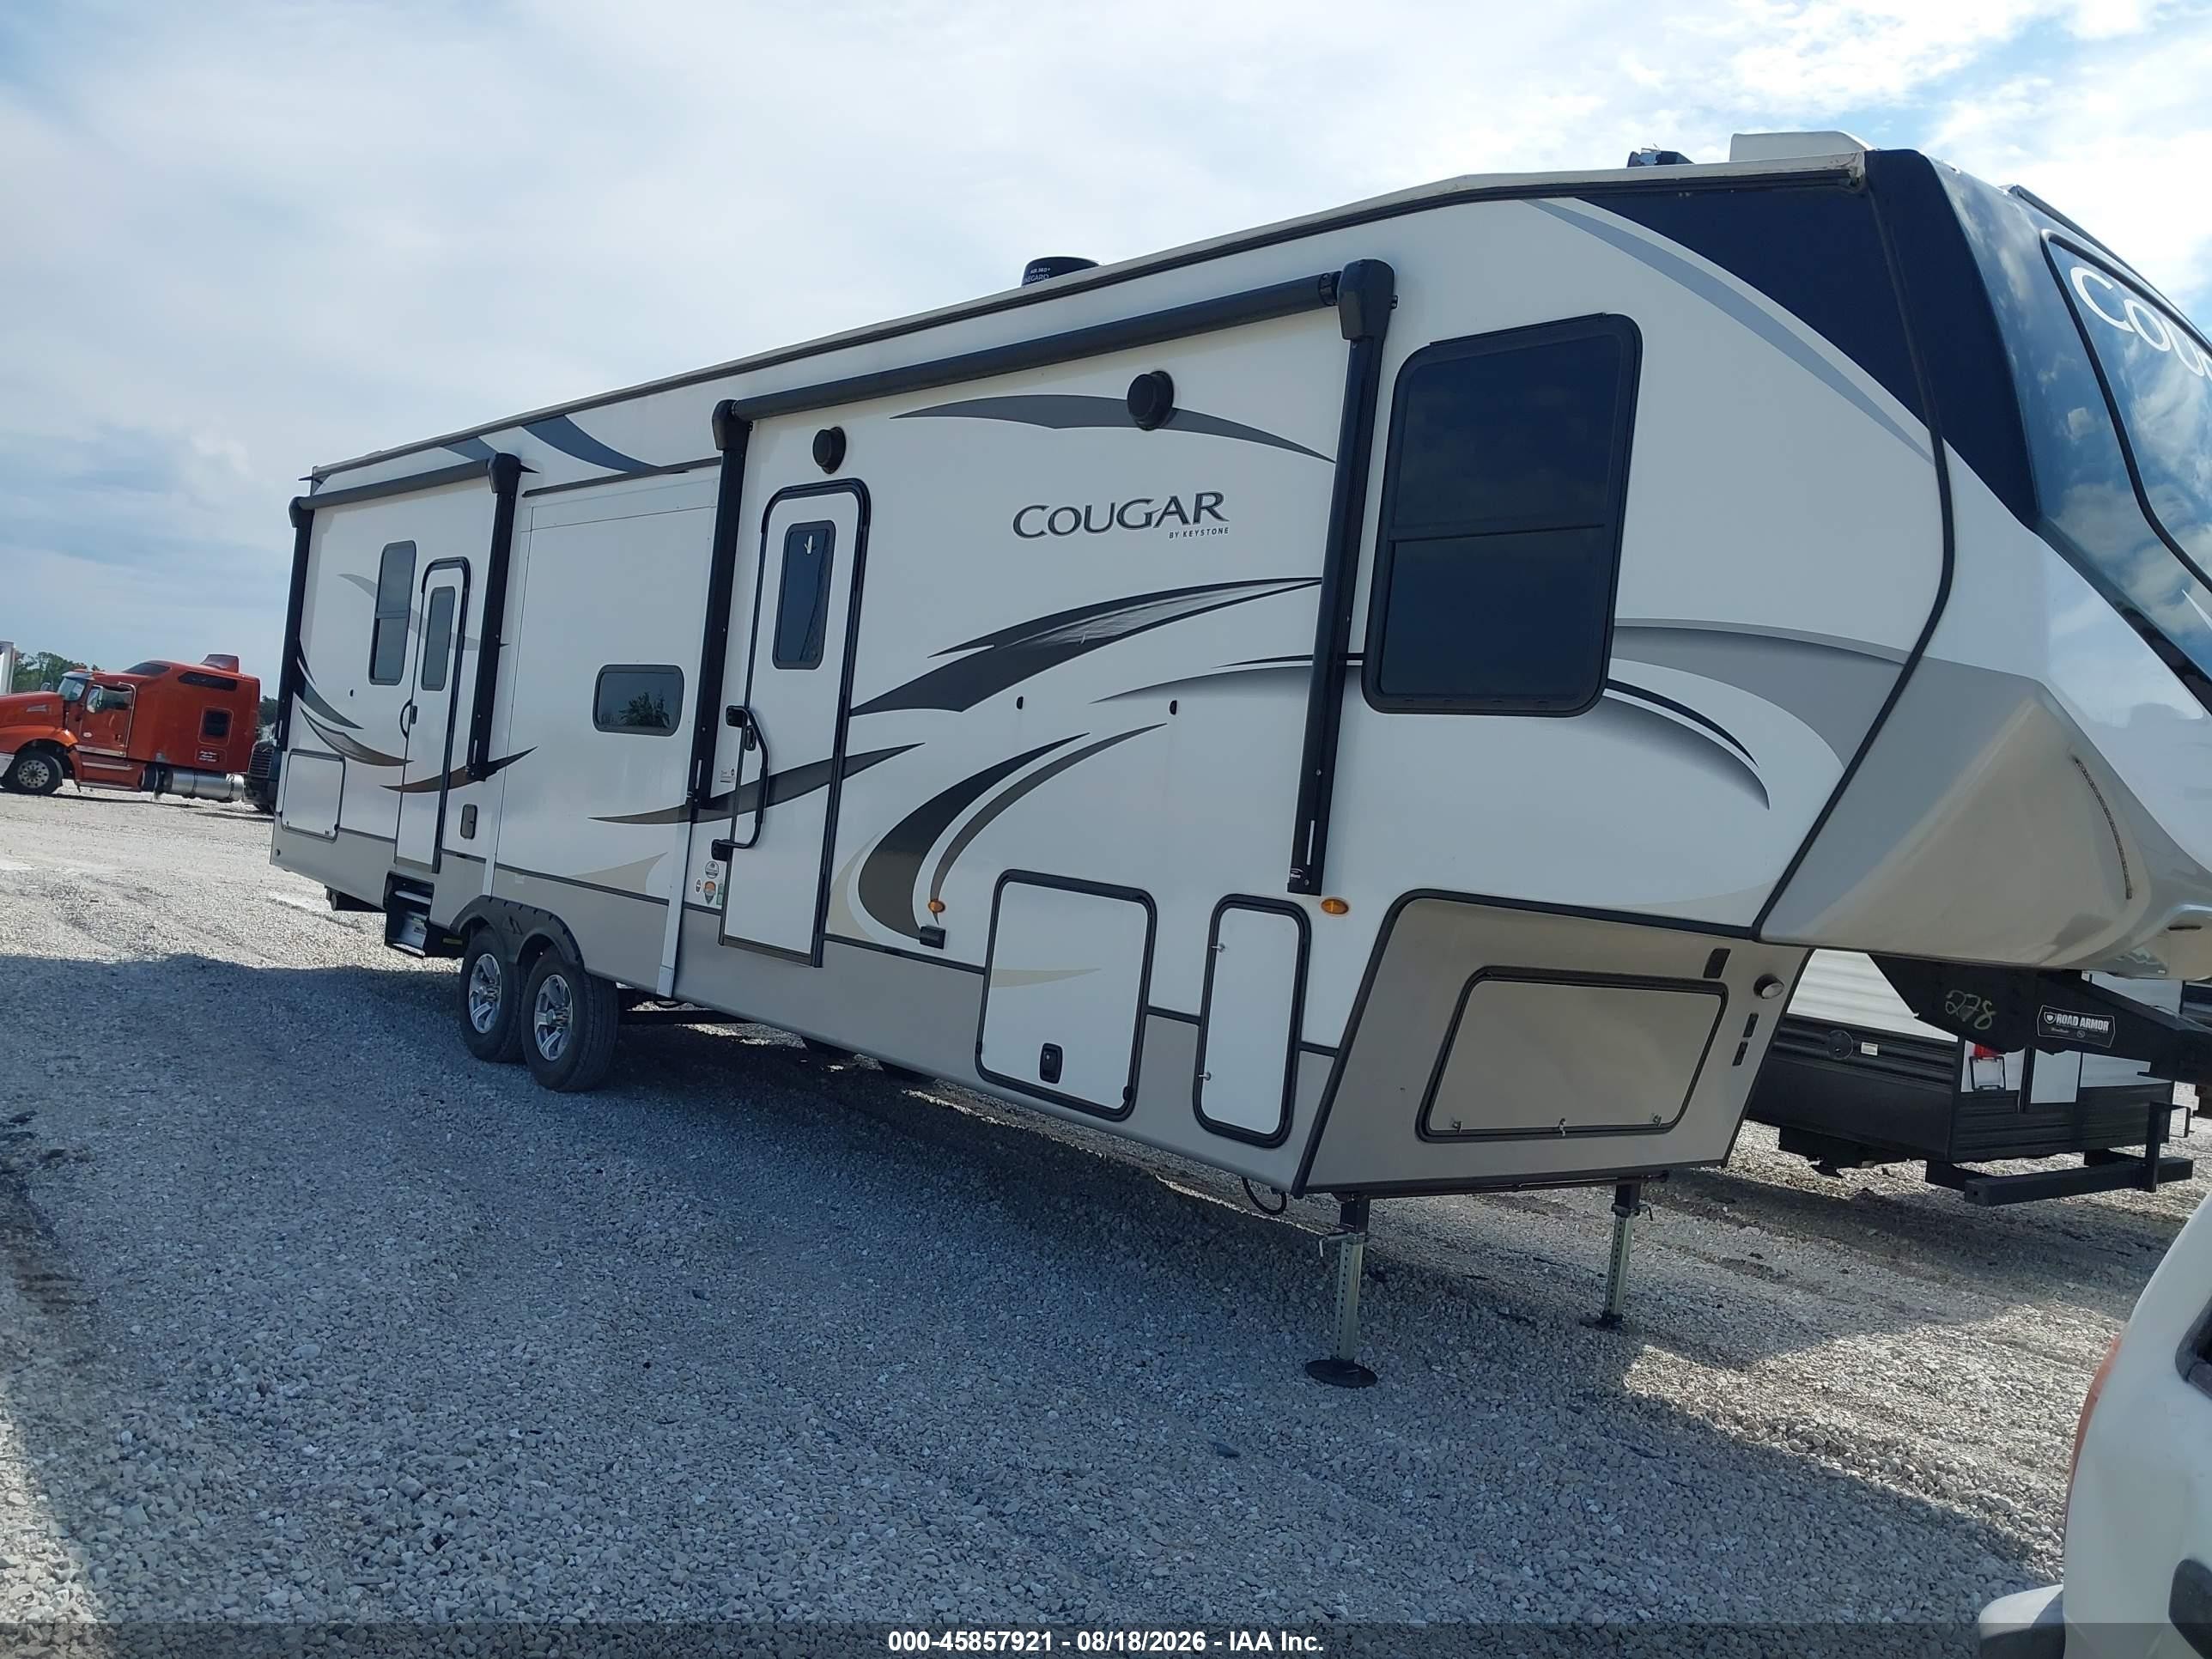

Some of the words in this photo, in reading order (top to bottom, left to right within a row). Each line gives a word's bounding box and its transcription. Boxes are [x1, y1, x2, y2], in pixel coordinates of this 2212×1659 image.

[1012, 490, 1230, 539] COUGAR
[1169, 531, 1180, 539] BY
[1182, 527, 1229, 538] KEYSTONE
[1945, 989, 1996, 1030] 278
[2056, 1013, 2079, 1026] ROAD
[2079, 1017, 2110, 1031] ARMOR
